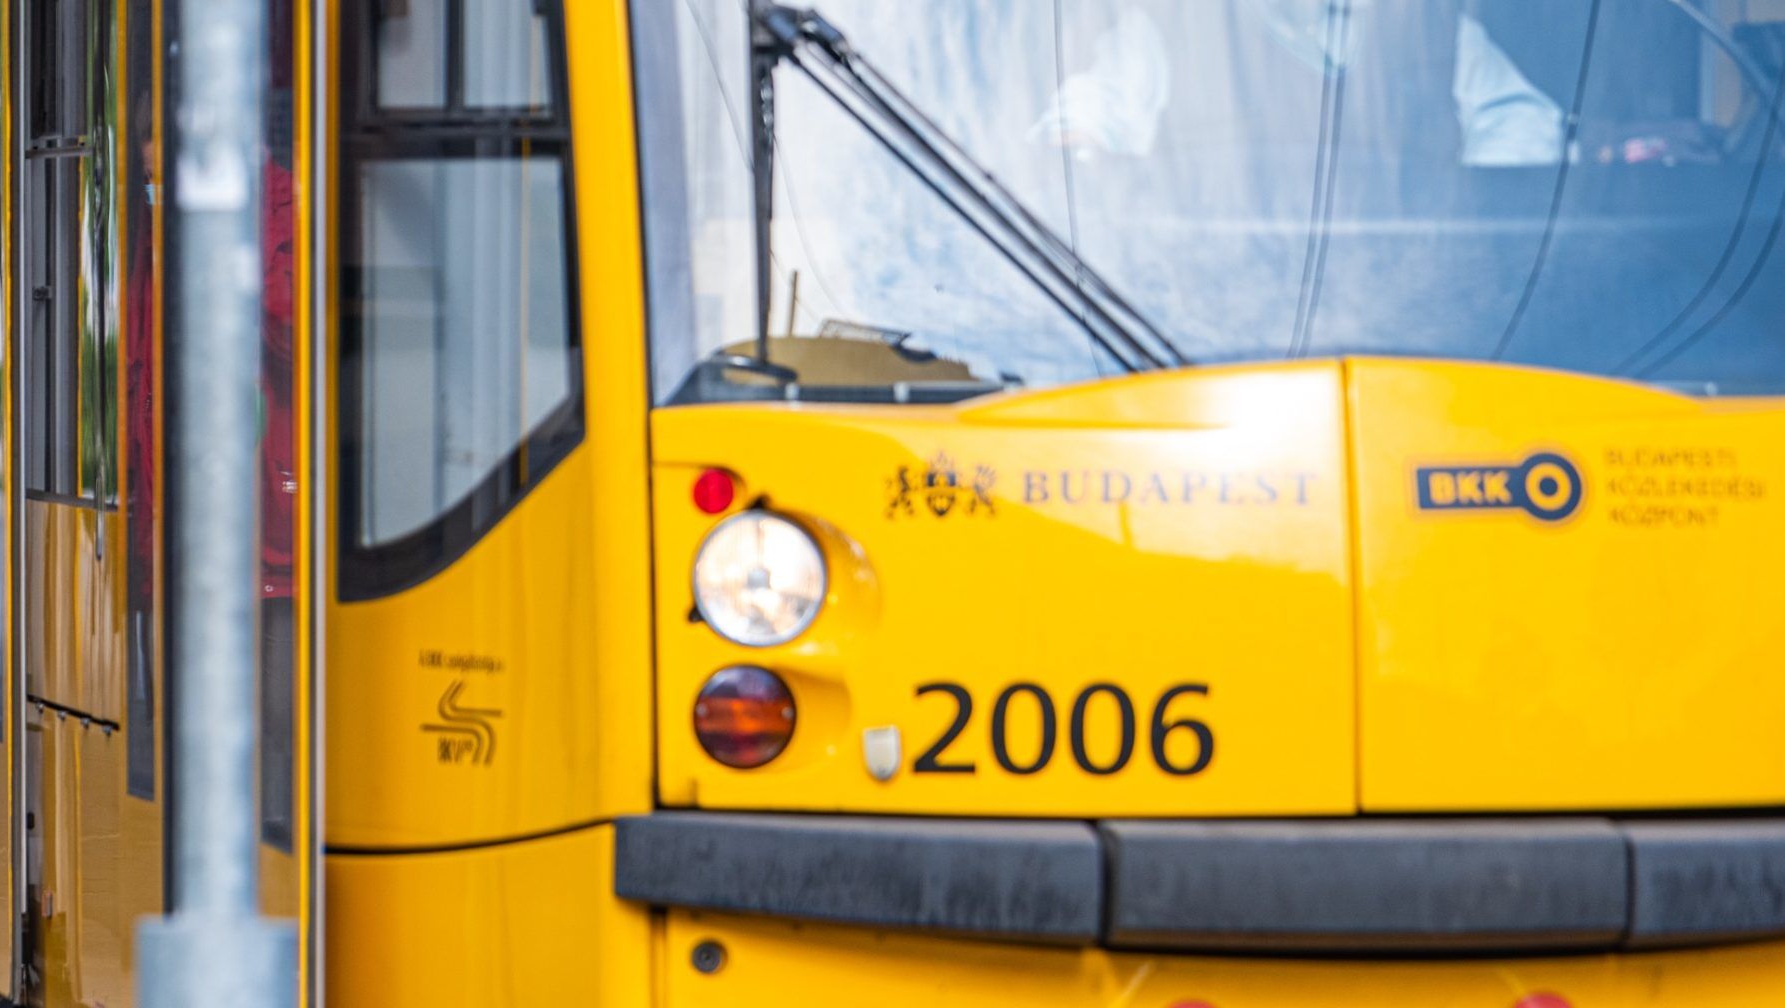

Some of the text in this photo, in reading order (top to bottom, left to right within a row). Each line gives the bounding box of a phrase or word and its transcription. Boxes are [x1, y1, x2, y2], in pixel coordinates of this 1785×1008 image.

[1022, 470, 1316, 505] BUDAPEST
[1427, 470, 1513, 506] BKK
[911, 682, 1215, 776] 2006
